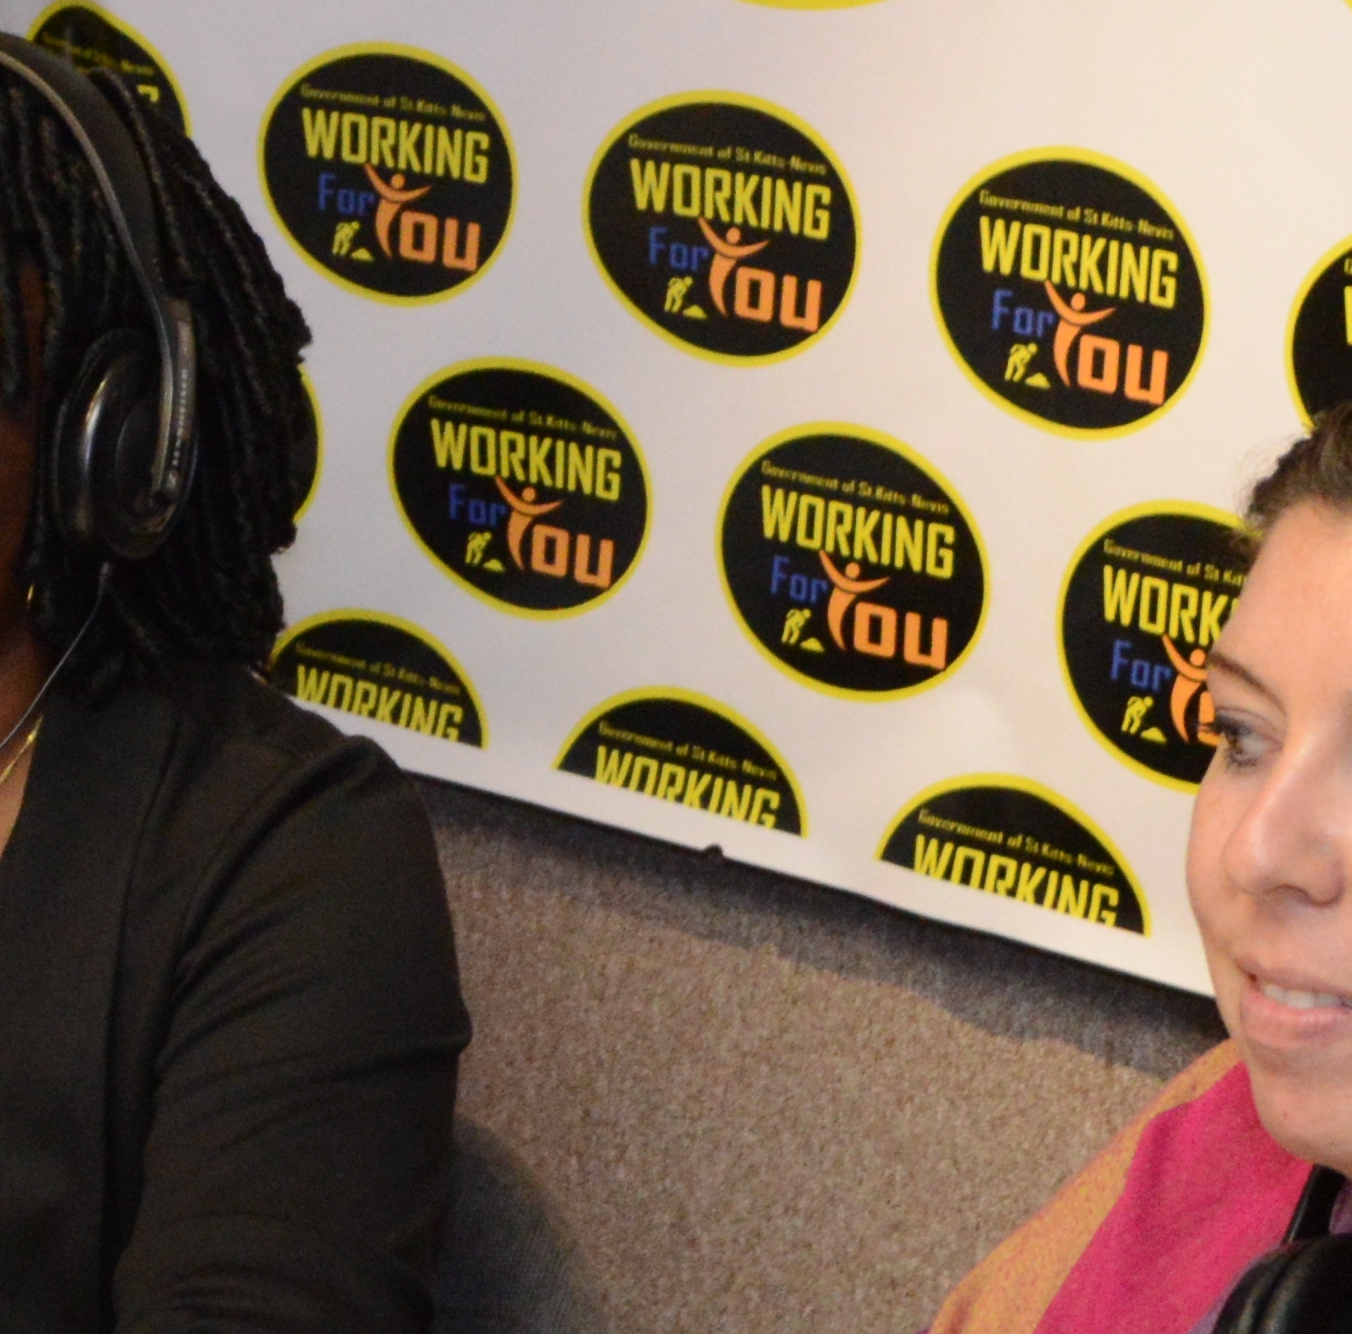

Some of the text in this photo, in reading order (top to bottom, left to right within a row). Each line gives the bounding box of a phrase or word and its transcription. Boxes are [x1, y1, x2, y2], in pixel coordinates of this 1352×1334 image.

[304, 106, 488, 185] WORKING
[318, 173, 377, 218] For
[633, 156, 830, 240] WORKING
[646, 226, 710, 273] For
[982, 215, 1178, 309] WORKING
[991, 288, 1055, 339] For
[432, 417, 620, 502] WORKING
[447, 483, 507, 529] For
[760, 487, 954, 579] WORKING
[769, 555, 831, 604] For
